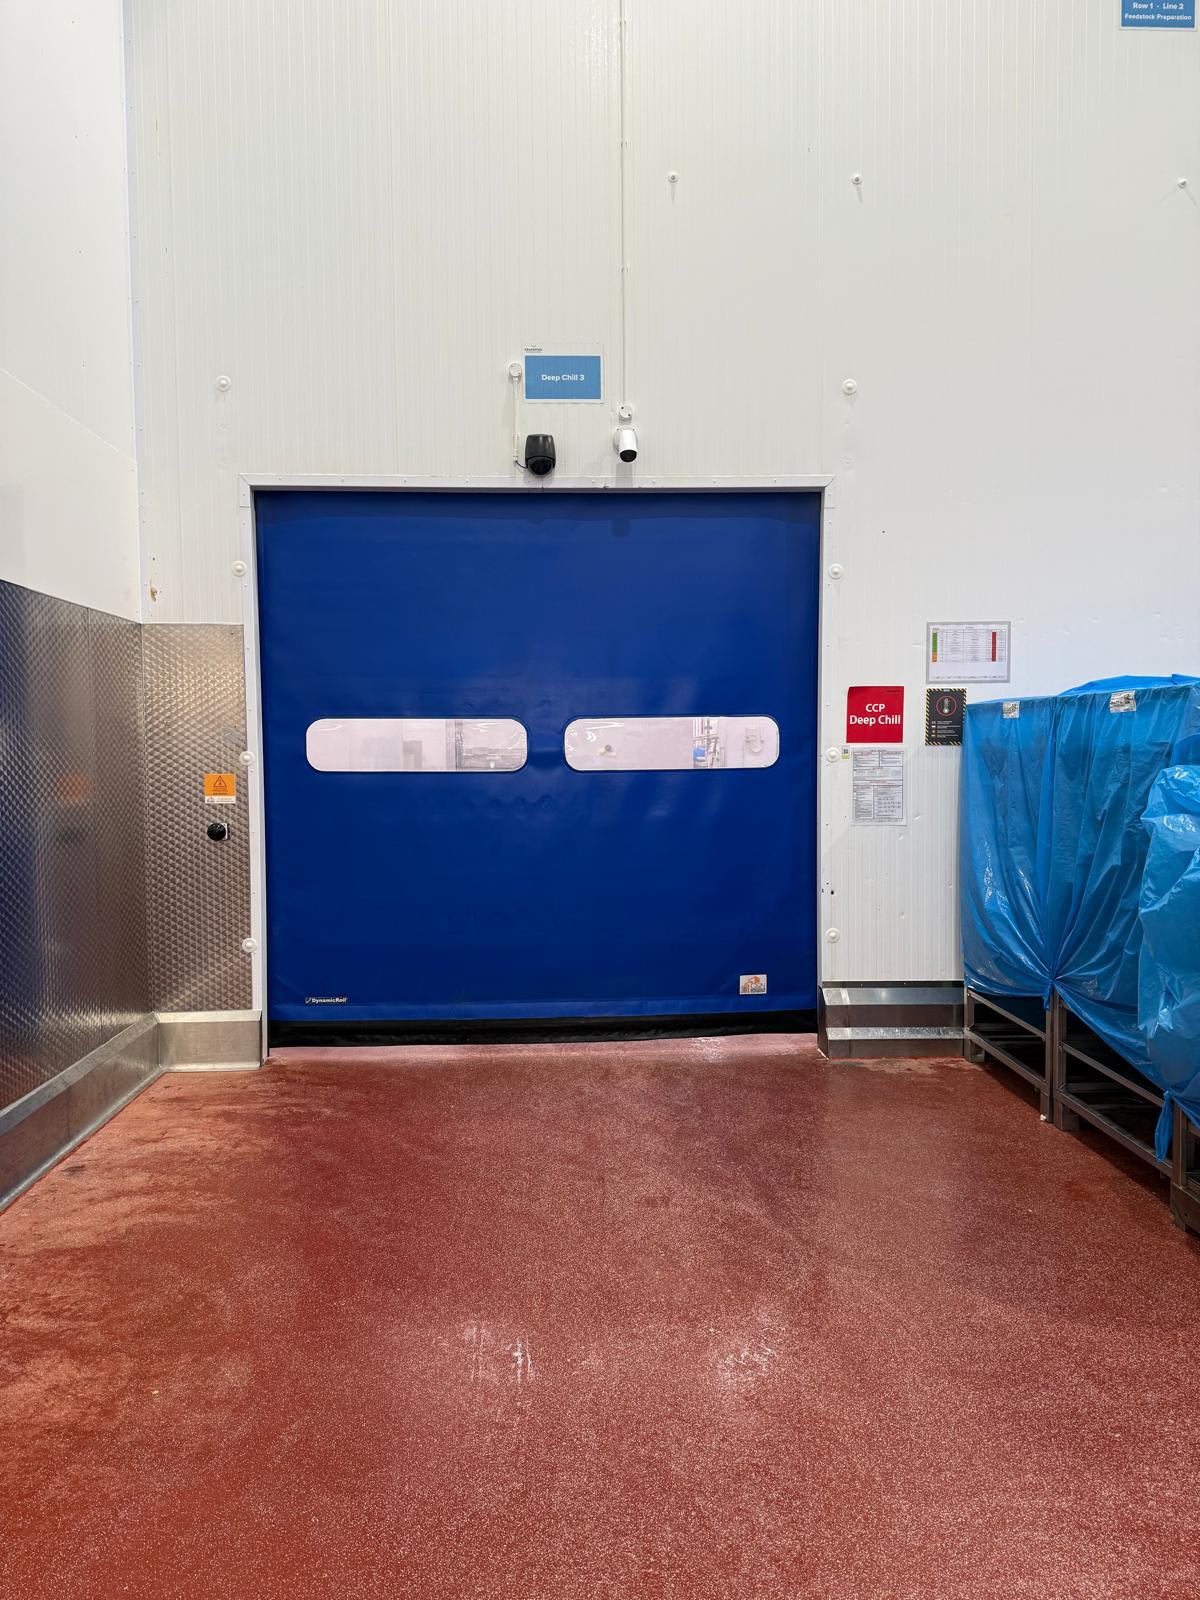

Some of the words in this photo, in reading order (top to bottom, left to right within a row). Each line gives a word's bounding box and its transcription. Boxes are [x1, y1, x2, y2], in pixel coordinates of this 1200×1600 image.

[1157, 13, 1192, 21] Preparation
[541, 374, 560, 383] Deep
[865, 703, 886, 713] CCP
[849, 715, 876, 727] Deep
[878, 714, 901, 725] Chill
